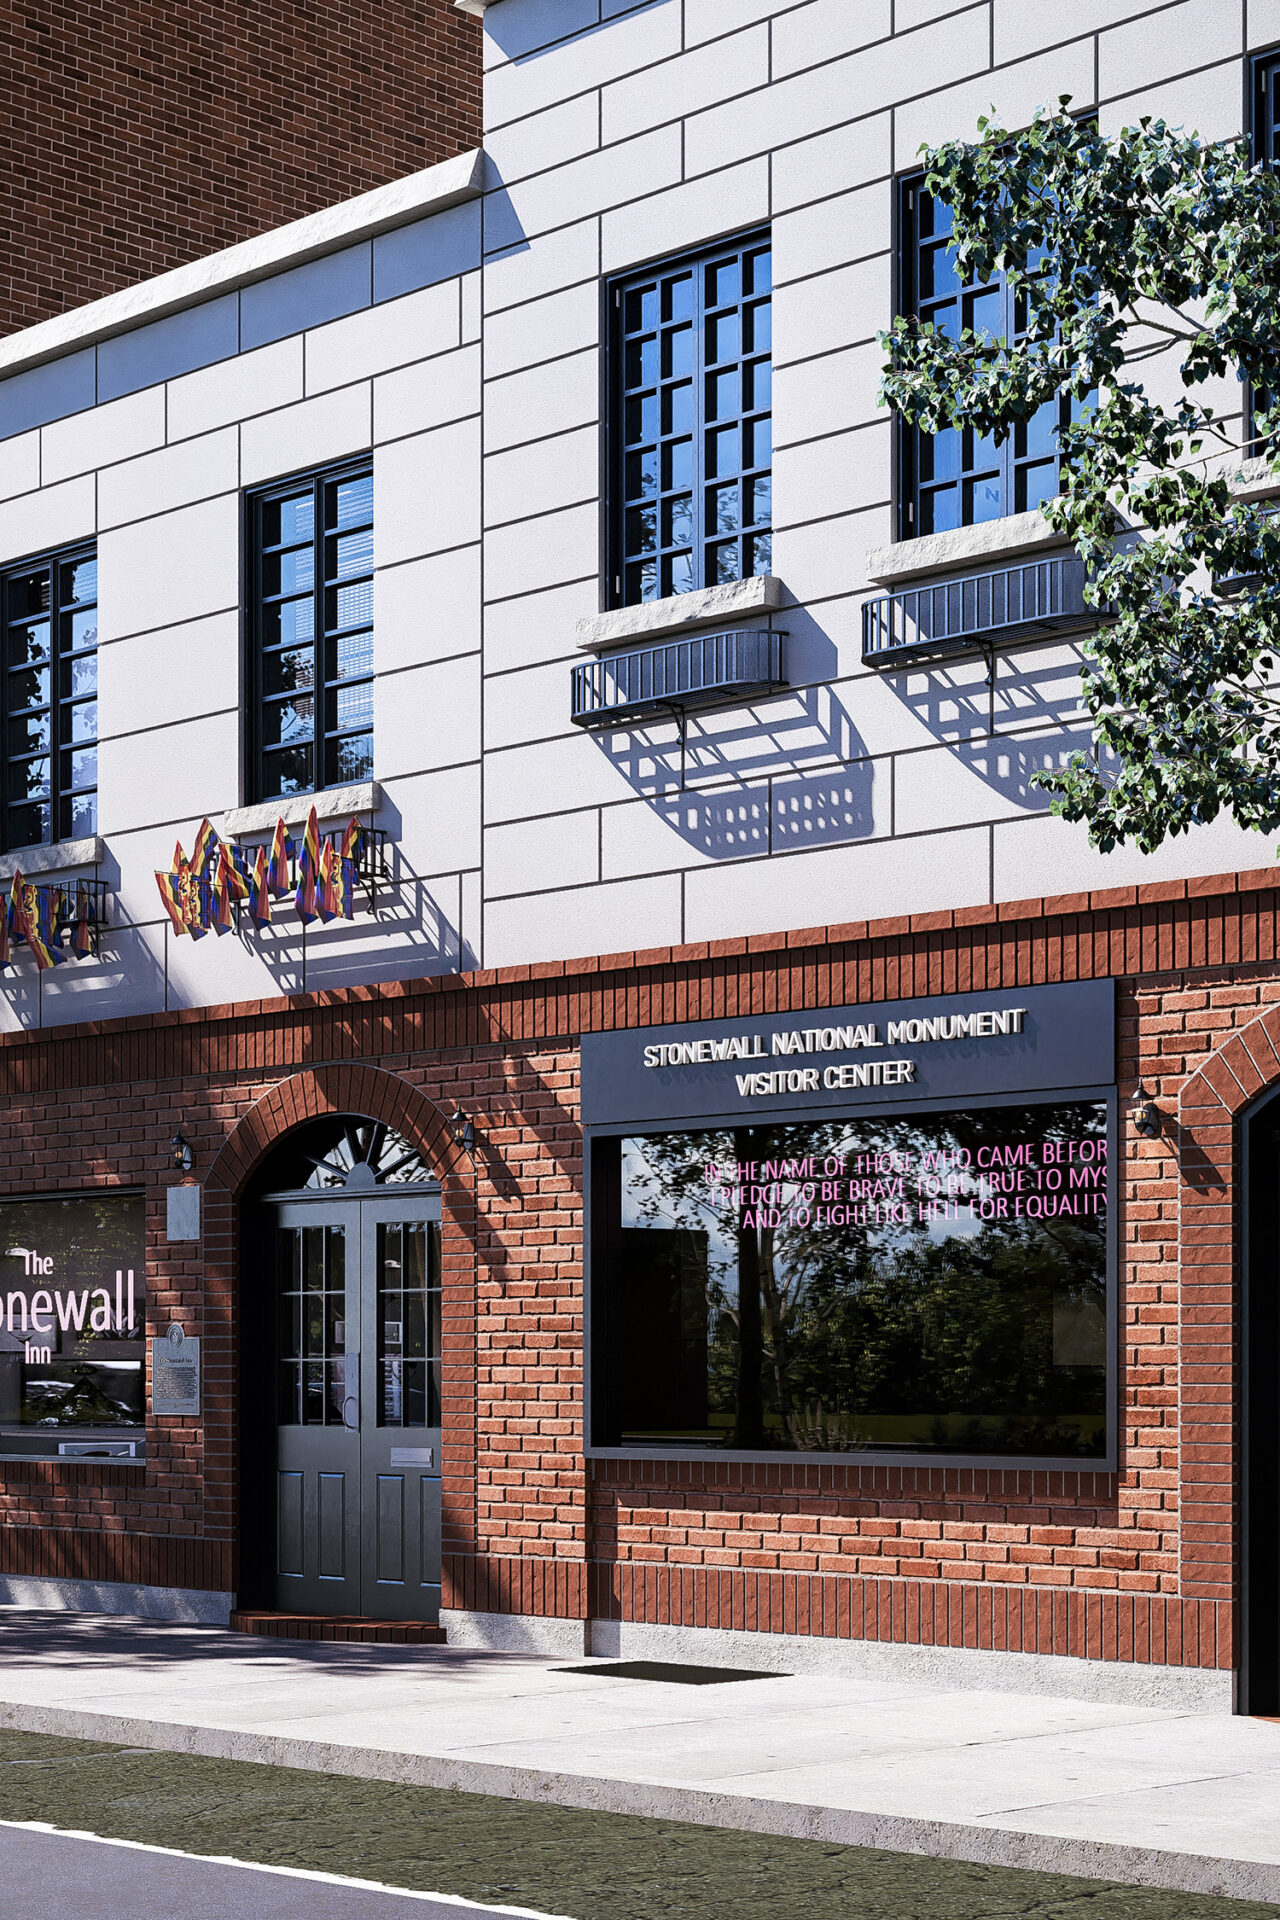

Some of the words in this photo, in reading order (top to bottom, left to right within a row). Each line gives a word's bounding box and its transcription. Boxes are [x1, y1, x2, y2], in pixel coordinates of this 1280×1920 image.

[643, 1034, 769, 1068] STONEWALL
[771, 1023, 884, 1056] NATIONAL
[887, 1008, 1027, 1045] MONUMENT
[735, 1068, 820, 1097] VISITOR
[823, 1060, 916, 1090] CENTER
[729, 1160, 760, 1181] THE
[765, 1157, 818, 1180] NAME
[823, 1155, 848, 1177] OF
[857, 1150, 915, 1176] THOSE
[920, 1147, 971, 1171] WHO
[977, 1143, 1035, 1168] CAME
[1043, 1138, 1107, 1164] BEFOR
[720, 1183, 785, 1206] PLEDGE
[791, 1182, 815, 1202] TO
[821, 1180, 843, 1201] BE
[849, 1176, 908, 1201] BRAVE
[916, 1175, 942, 1197] TO
[948, 1173, 971, 1195] BE
[977, 1170, 1028, 1193] TRUE
[1035, 1168, 1063, 1190] TO
[742, 1208, 782, 1230] AND
[787, 1207, 811, 1227] TO
[816, 1202, 869, 1226] FIGHT
[875, 1201, 912, 1224] LIKE
[918, 1198, 960, 1222] HELL
[970, 1198, 1009, 1220] FOR
[23, 1250, 54, 1275] The
[0, 1269, 134, 1332] newall
[24, 1340, 51, 1364] Inn
